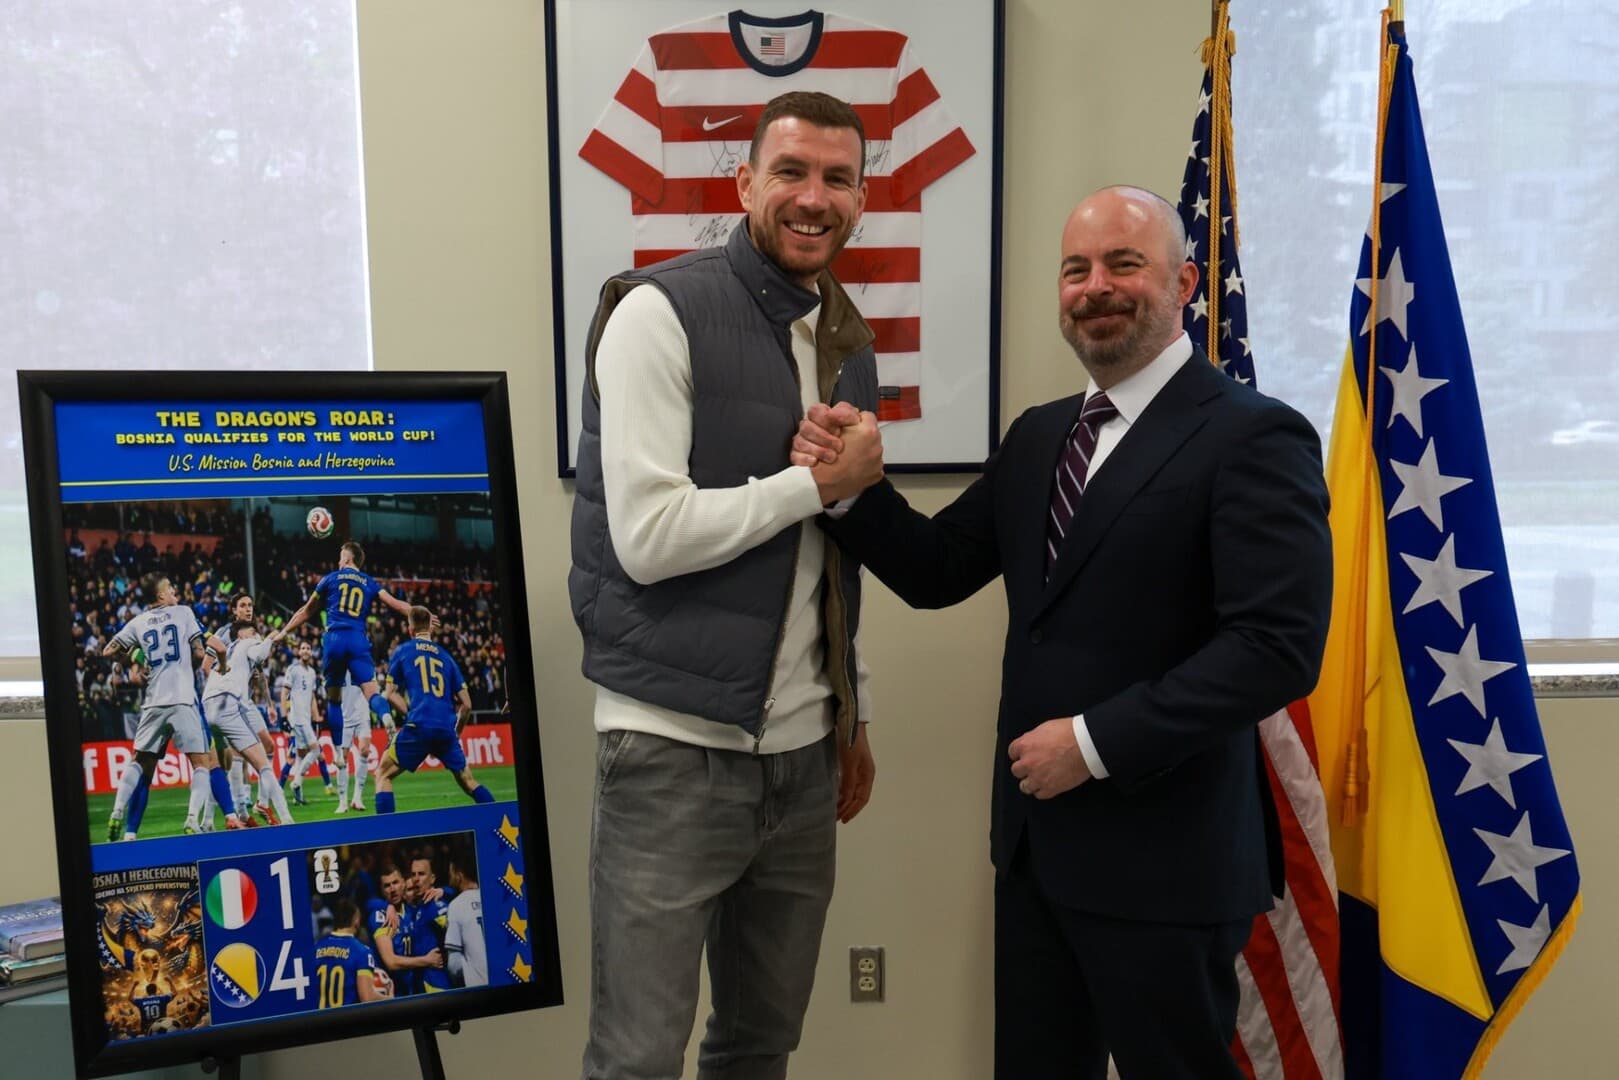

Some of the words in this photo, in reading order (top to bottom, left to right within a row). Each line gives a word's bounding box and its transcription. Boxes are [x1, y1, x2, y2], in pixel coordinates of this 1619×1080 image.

[156, 411, 200, 427] THE
[216, 411, 317, 427] DRAGON'S
[330, 410, 394, 426] ROAR:
[115, 433, 175, 444] BOSNIA
[184, 432, 269, 444] QUALIFIES
[278, 432, 306, 442] FOR
[314, 431, 341, 442] THE
[350, 431, 394, 441] WORLD
[402, 430, 435, 441] CUP!
[168, 454, 194, 471] U.S.
[198, 454, 247, 470] Mission
[252, 453, 294, 470] Bosnia
[297, 453, 322, 468] and
[325, 451, 396, 471] Herzegovina
[338, 583, 364, 617] 10
[143, 624, 180, 667] 23
[414, 655, 444, 698] 15
[129, 866, 198, 882] HERCEGOVINA
[270, 857, 294, 930] 1
[269, 940, 310, 1001] 4
[317, 965, 345, 1009] 10
[144, 1004, 160, 1018] 10
